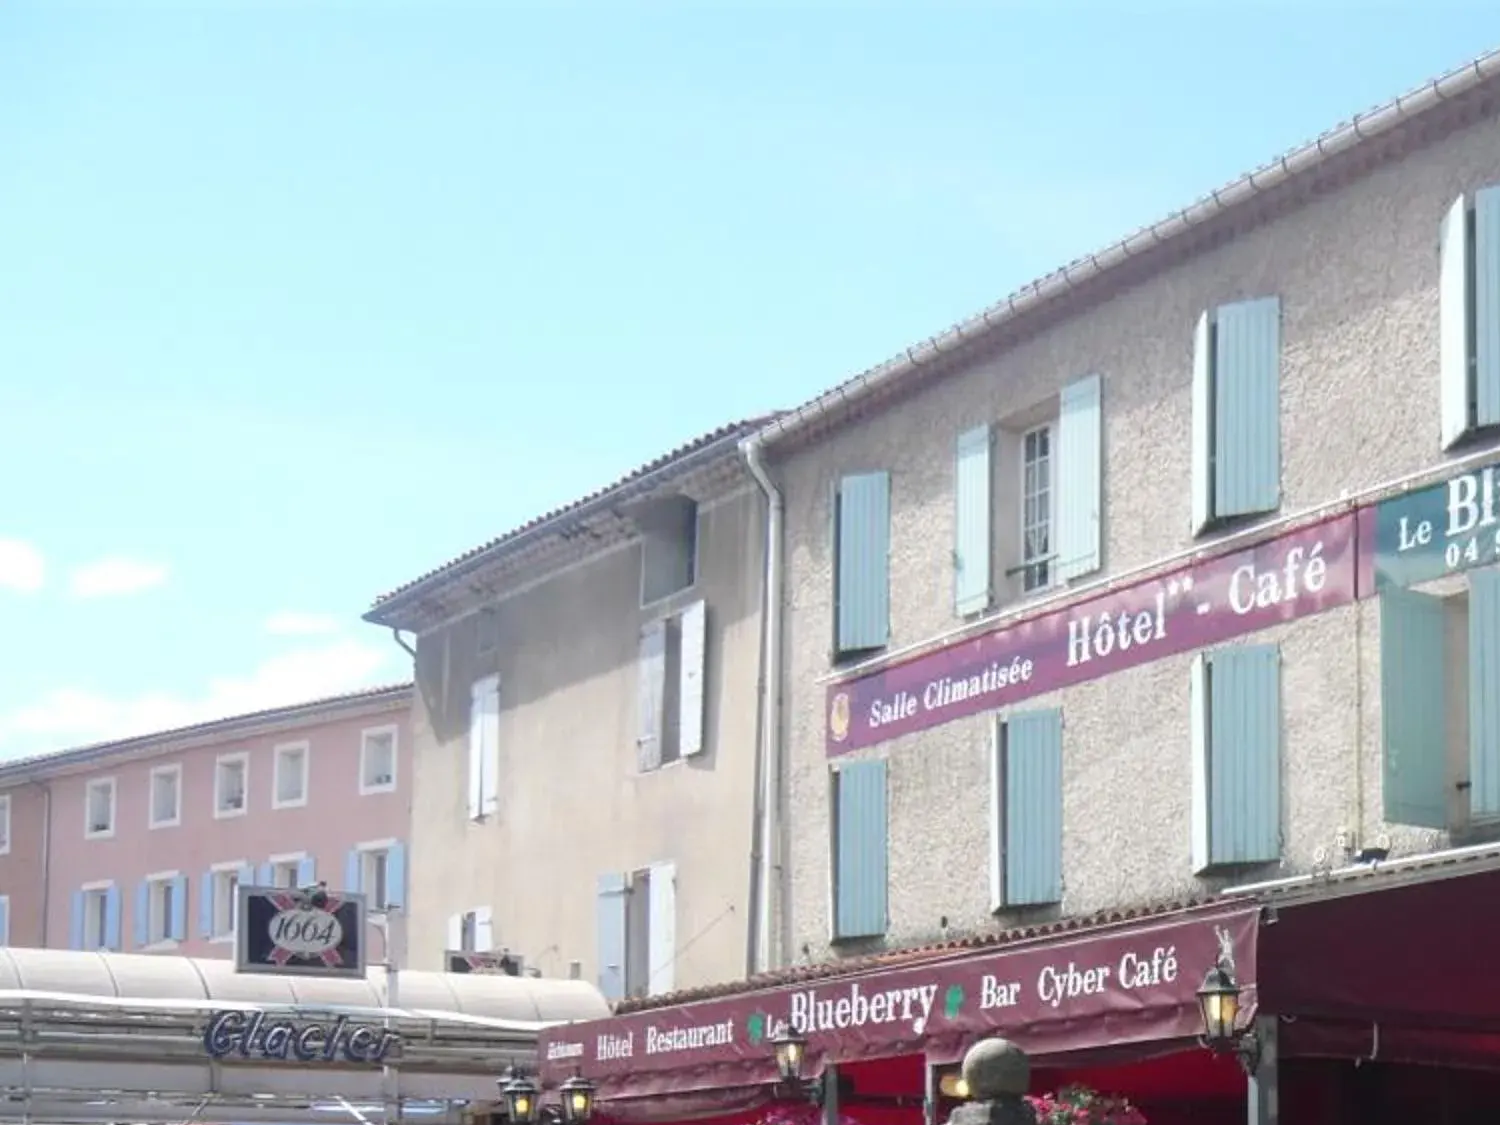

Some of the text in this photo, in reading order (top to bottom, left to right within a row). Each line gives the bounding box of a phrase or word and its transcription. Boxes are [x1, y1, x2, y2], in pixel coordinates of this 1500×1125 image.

[1398, 517, 1432, 552] Le
[1445, 538, 1479, 568] 04
[869, 692, 917, 729] Salle
[923, 655, 1034, 711] Climatisée
[1228, 541, 1327, 614] Café
[274, 915, 336, 945] 1664
[597, 1031, 634, 1061] Hôtel
[646, 1018, 735, 1055] Restaurant
[767, 1013, 789, 1039] Le
[791, 983, 938, 1035] Blueberry
[980, 975, 1021, 1010] Bar
[1037, 961, 1111, 1007] Cyber
[1119, 946, 1178, 989] Café
[204, 1009, 400, 1060] Glacier
